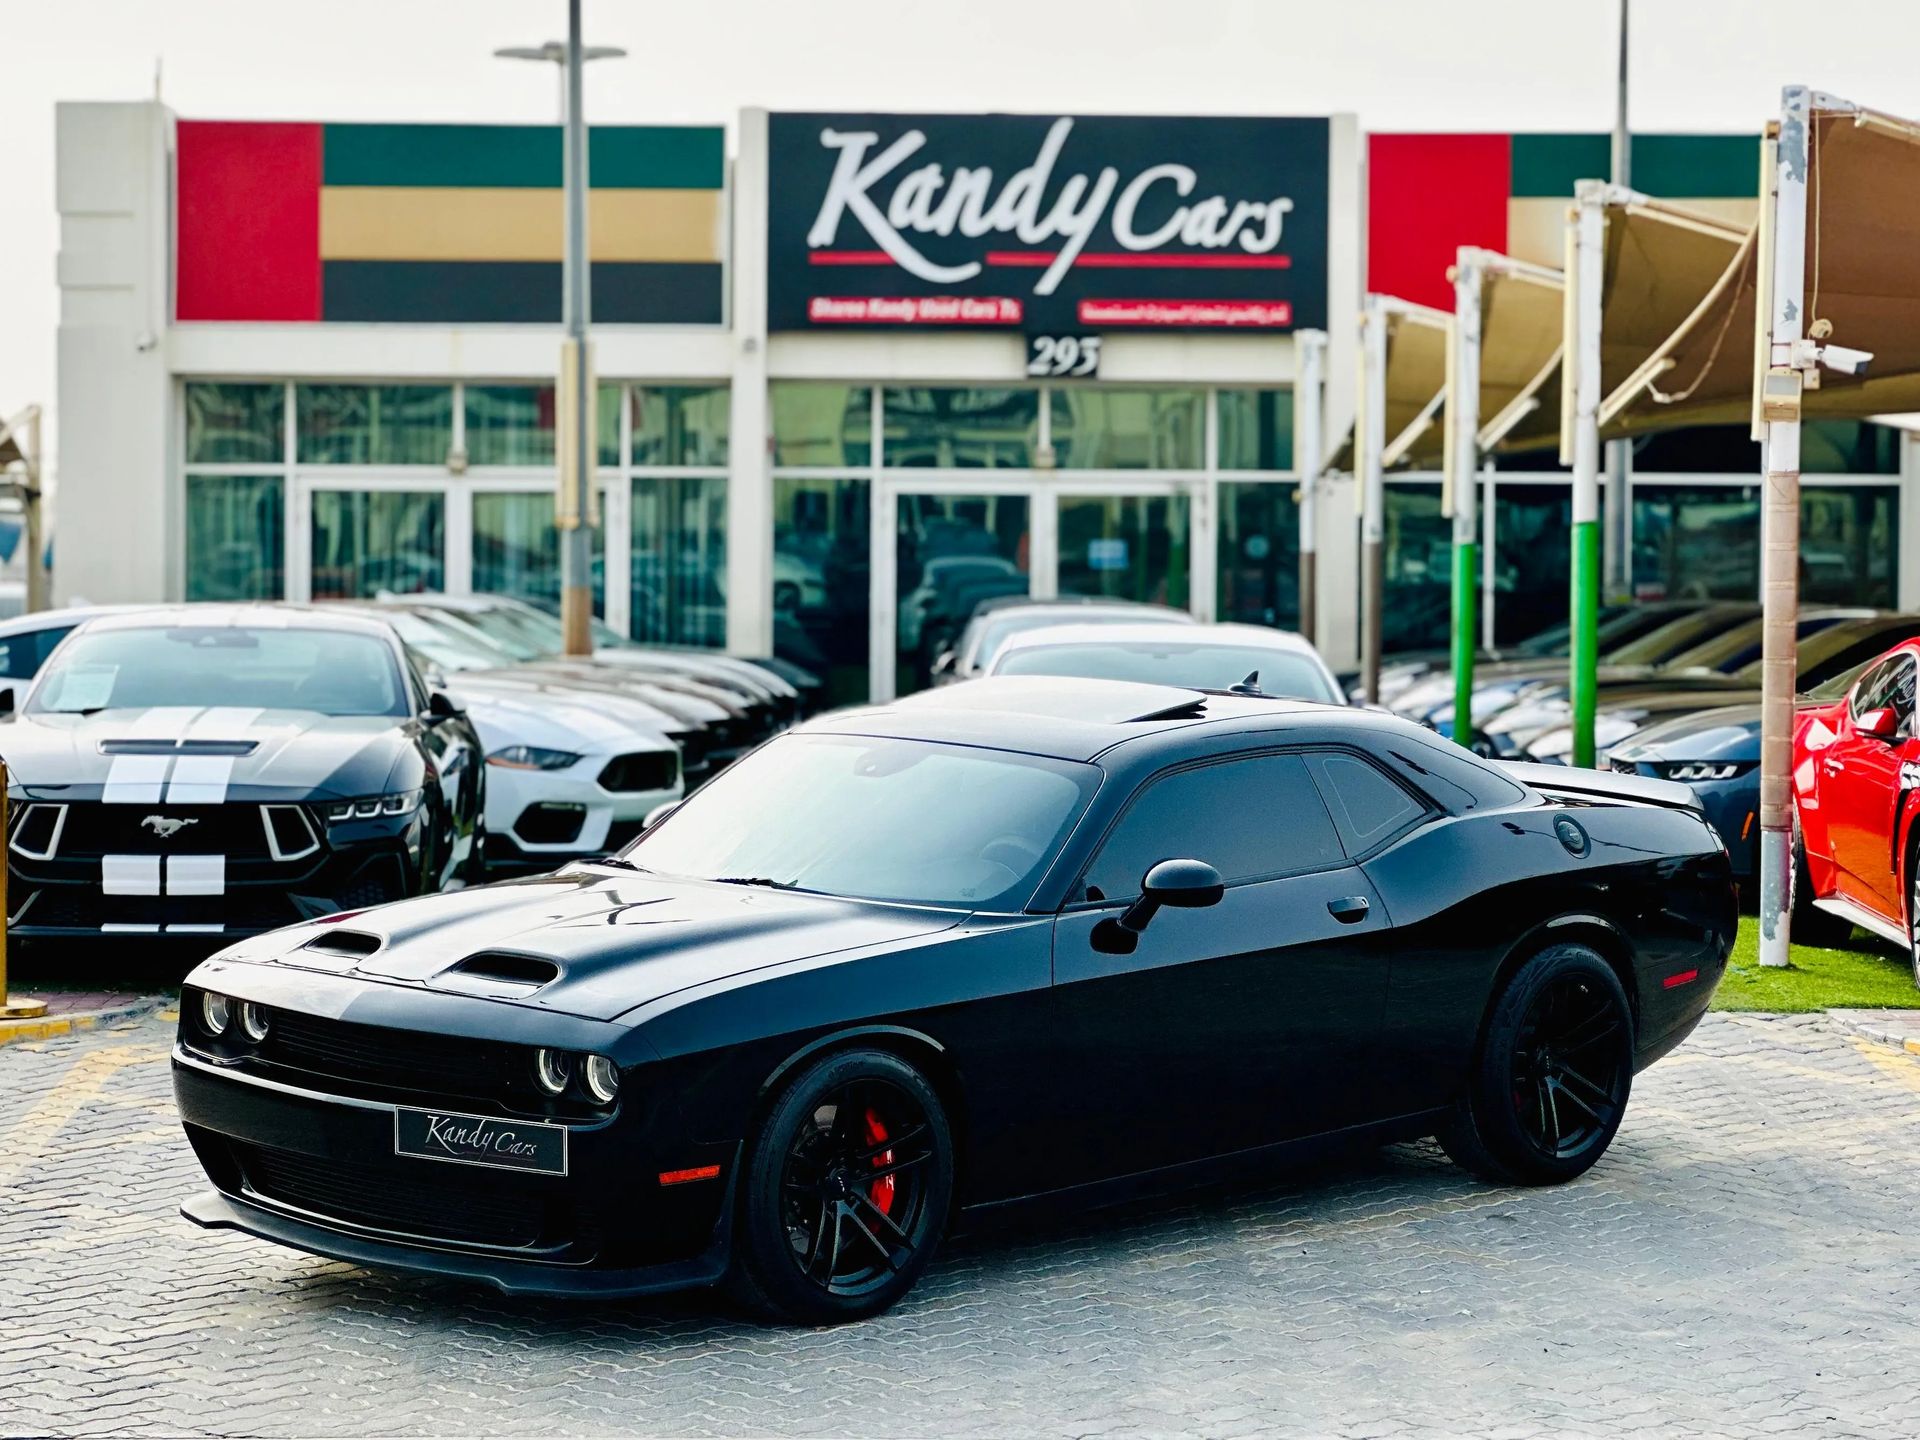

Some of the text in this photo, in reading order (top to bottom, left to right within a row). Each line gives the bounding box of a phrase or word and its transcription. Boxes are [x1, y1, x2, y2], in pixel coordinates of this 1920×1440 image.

[807, 117, 1293, 295] Kandy Cars
[1027, 336, 1102, 376] 295
[425, 1115, 538, 1161] Kandy Cars
